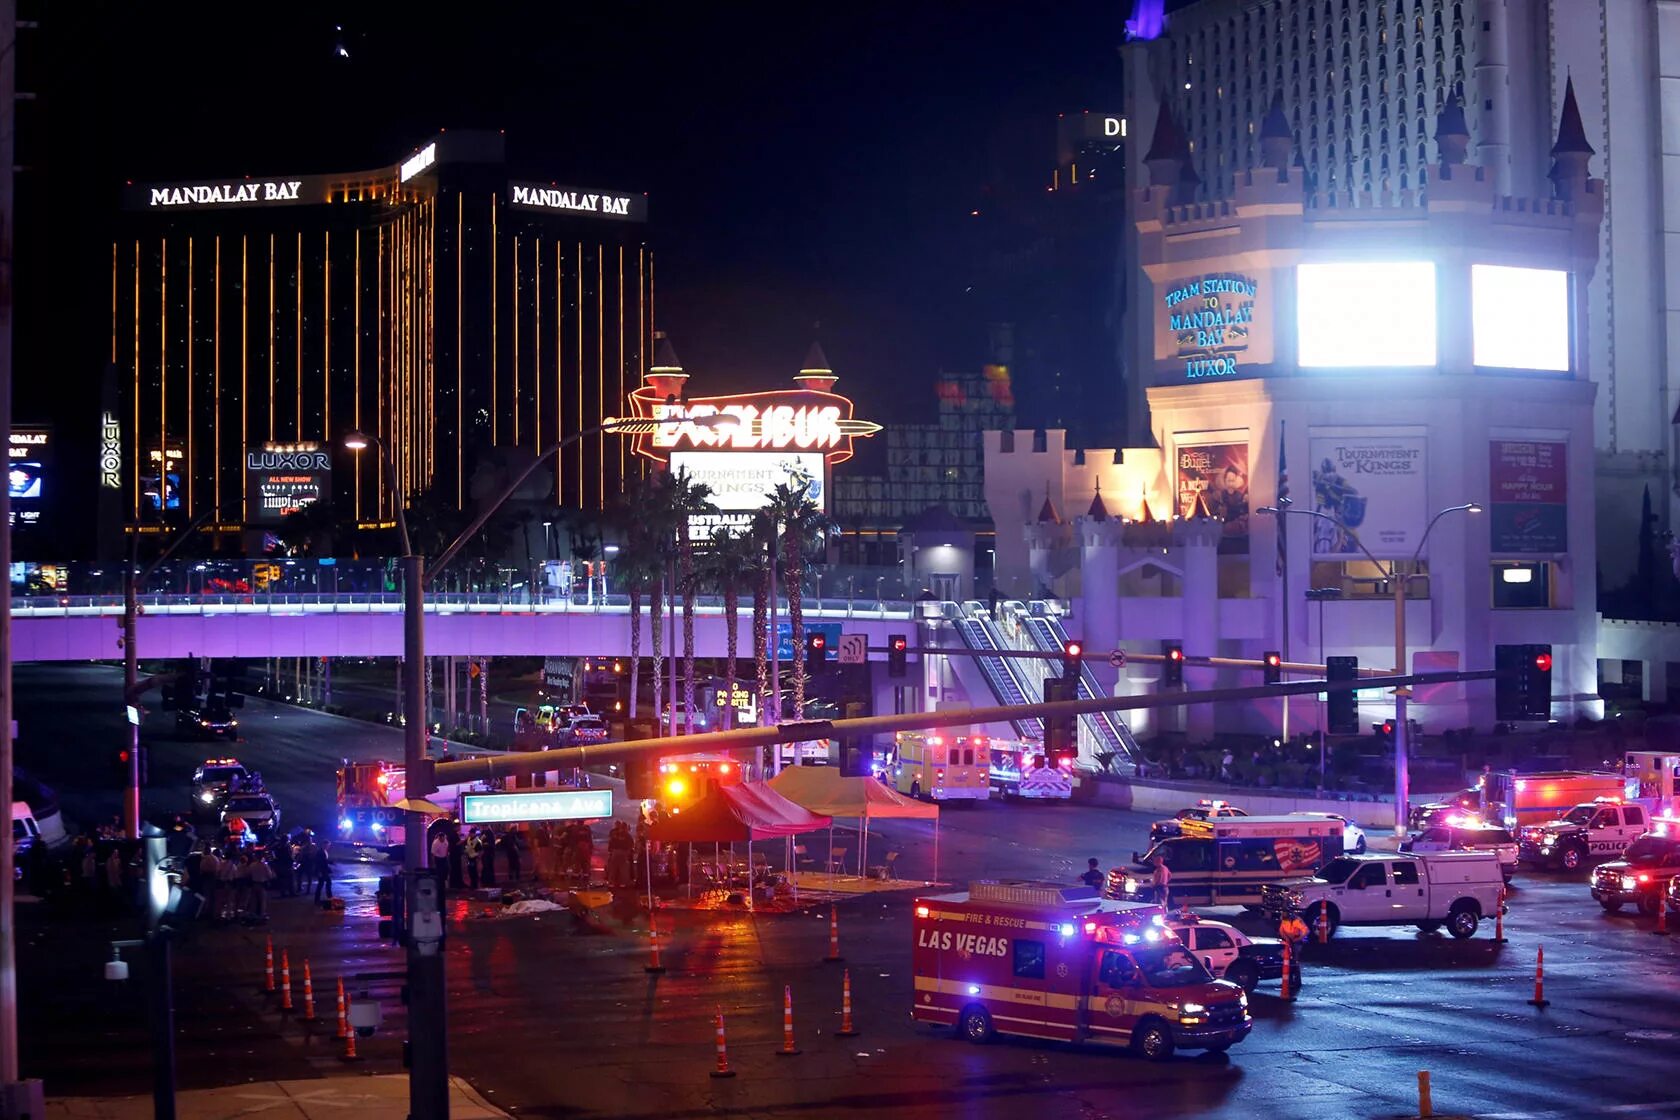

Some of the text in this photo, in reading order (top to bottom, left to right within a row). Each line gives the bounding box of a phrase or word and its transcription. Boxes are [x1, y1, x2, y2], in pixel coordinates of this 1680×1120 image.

[151, 182, 301, 205] MANDALAY BAY
[513, 186, 630, 215] MANDALAY BAY
[1165, 279, 1255, 308] TRAM STATION
[1203, 297, 1219, 309] TO
[1169, 307, 1252, 331] MANDALAY
[1197, 329, 1224, 347] BAY
[1186, 358, 1236, 378] LUXOR
[102, 412, 120, 487] LUXOR
[1336, 447, 1420, 461] TOURNAMENT
[248, 453, 331, 470] LUXOR
[1354, 459, 1412, 474] KINGS
[717, 690, 749, 699] PAKING
[356, 811, 366, 822] E
[471, 797, 604, 818] Tropicana Ave
[1591, 842, 1628, 851] POLICE
[964, 912, 1025, 928] FIRE & RESCUE
[918, 929, 1008, 957] LAS VEGAS
